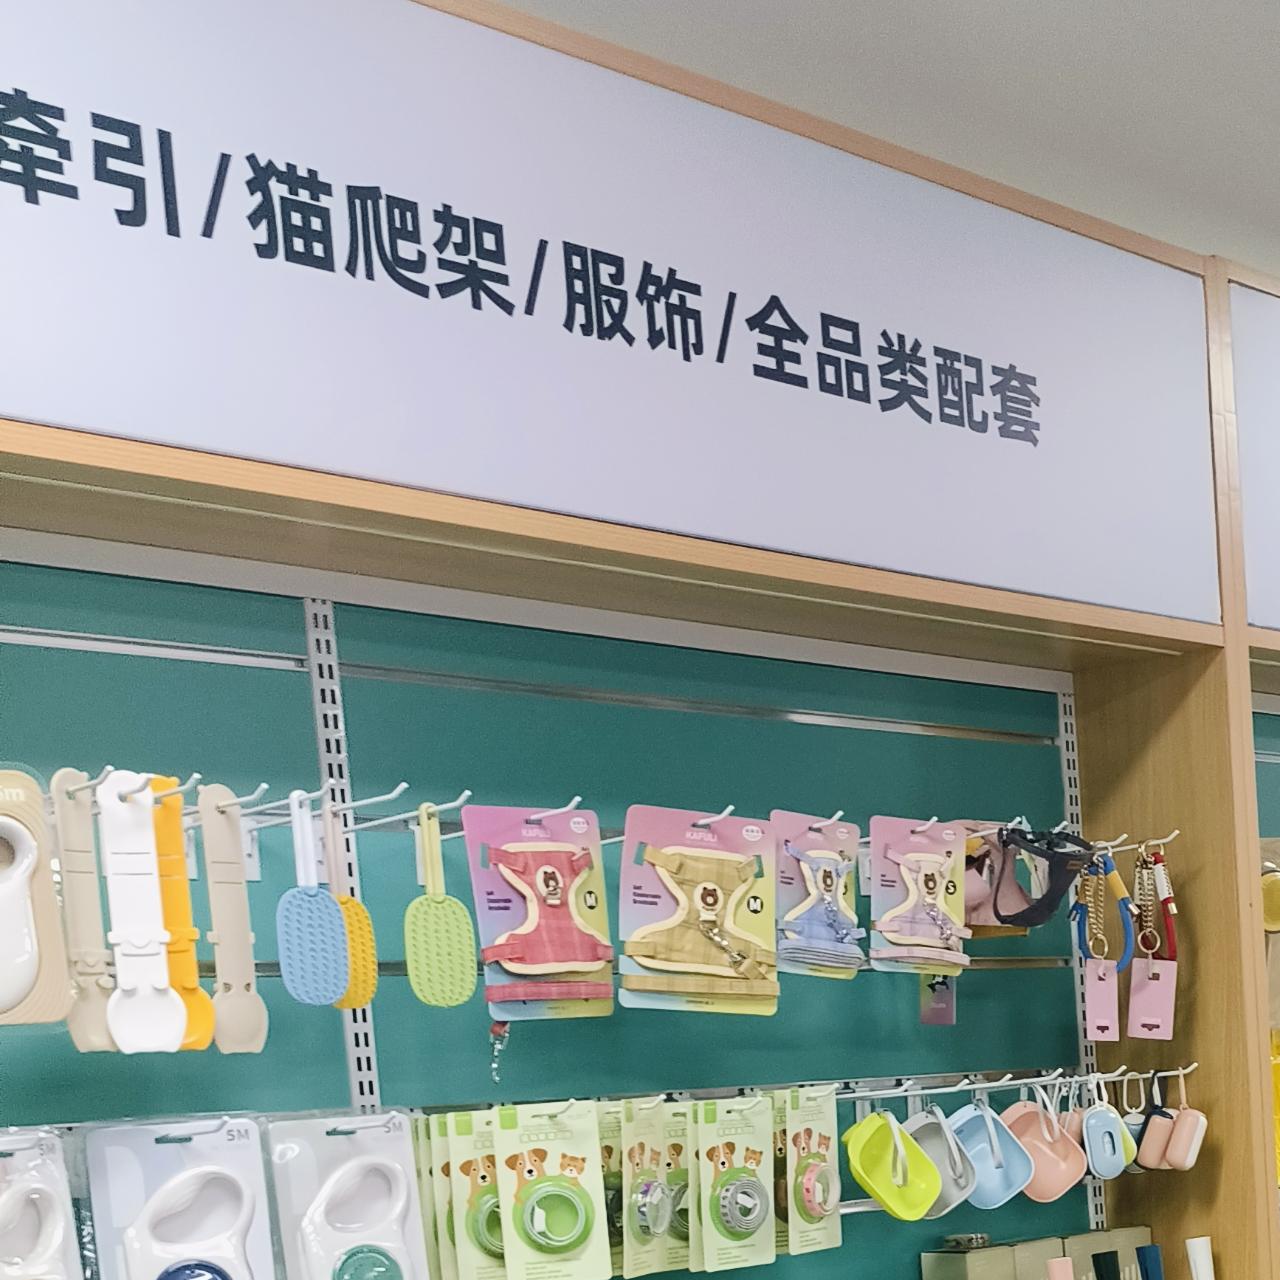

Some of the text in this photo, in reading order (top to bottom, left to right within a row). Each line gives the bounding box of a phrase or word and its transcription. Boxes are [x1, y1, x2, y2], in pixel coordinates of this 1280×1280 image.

[0, 87, 1041, 447] 牵引/猫爬架/服饰/全品类配套
